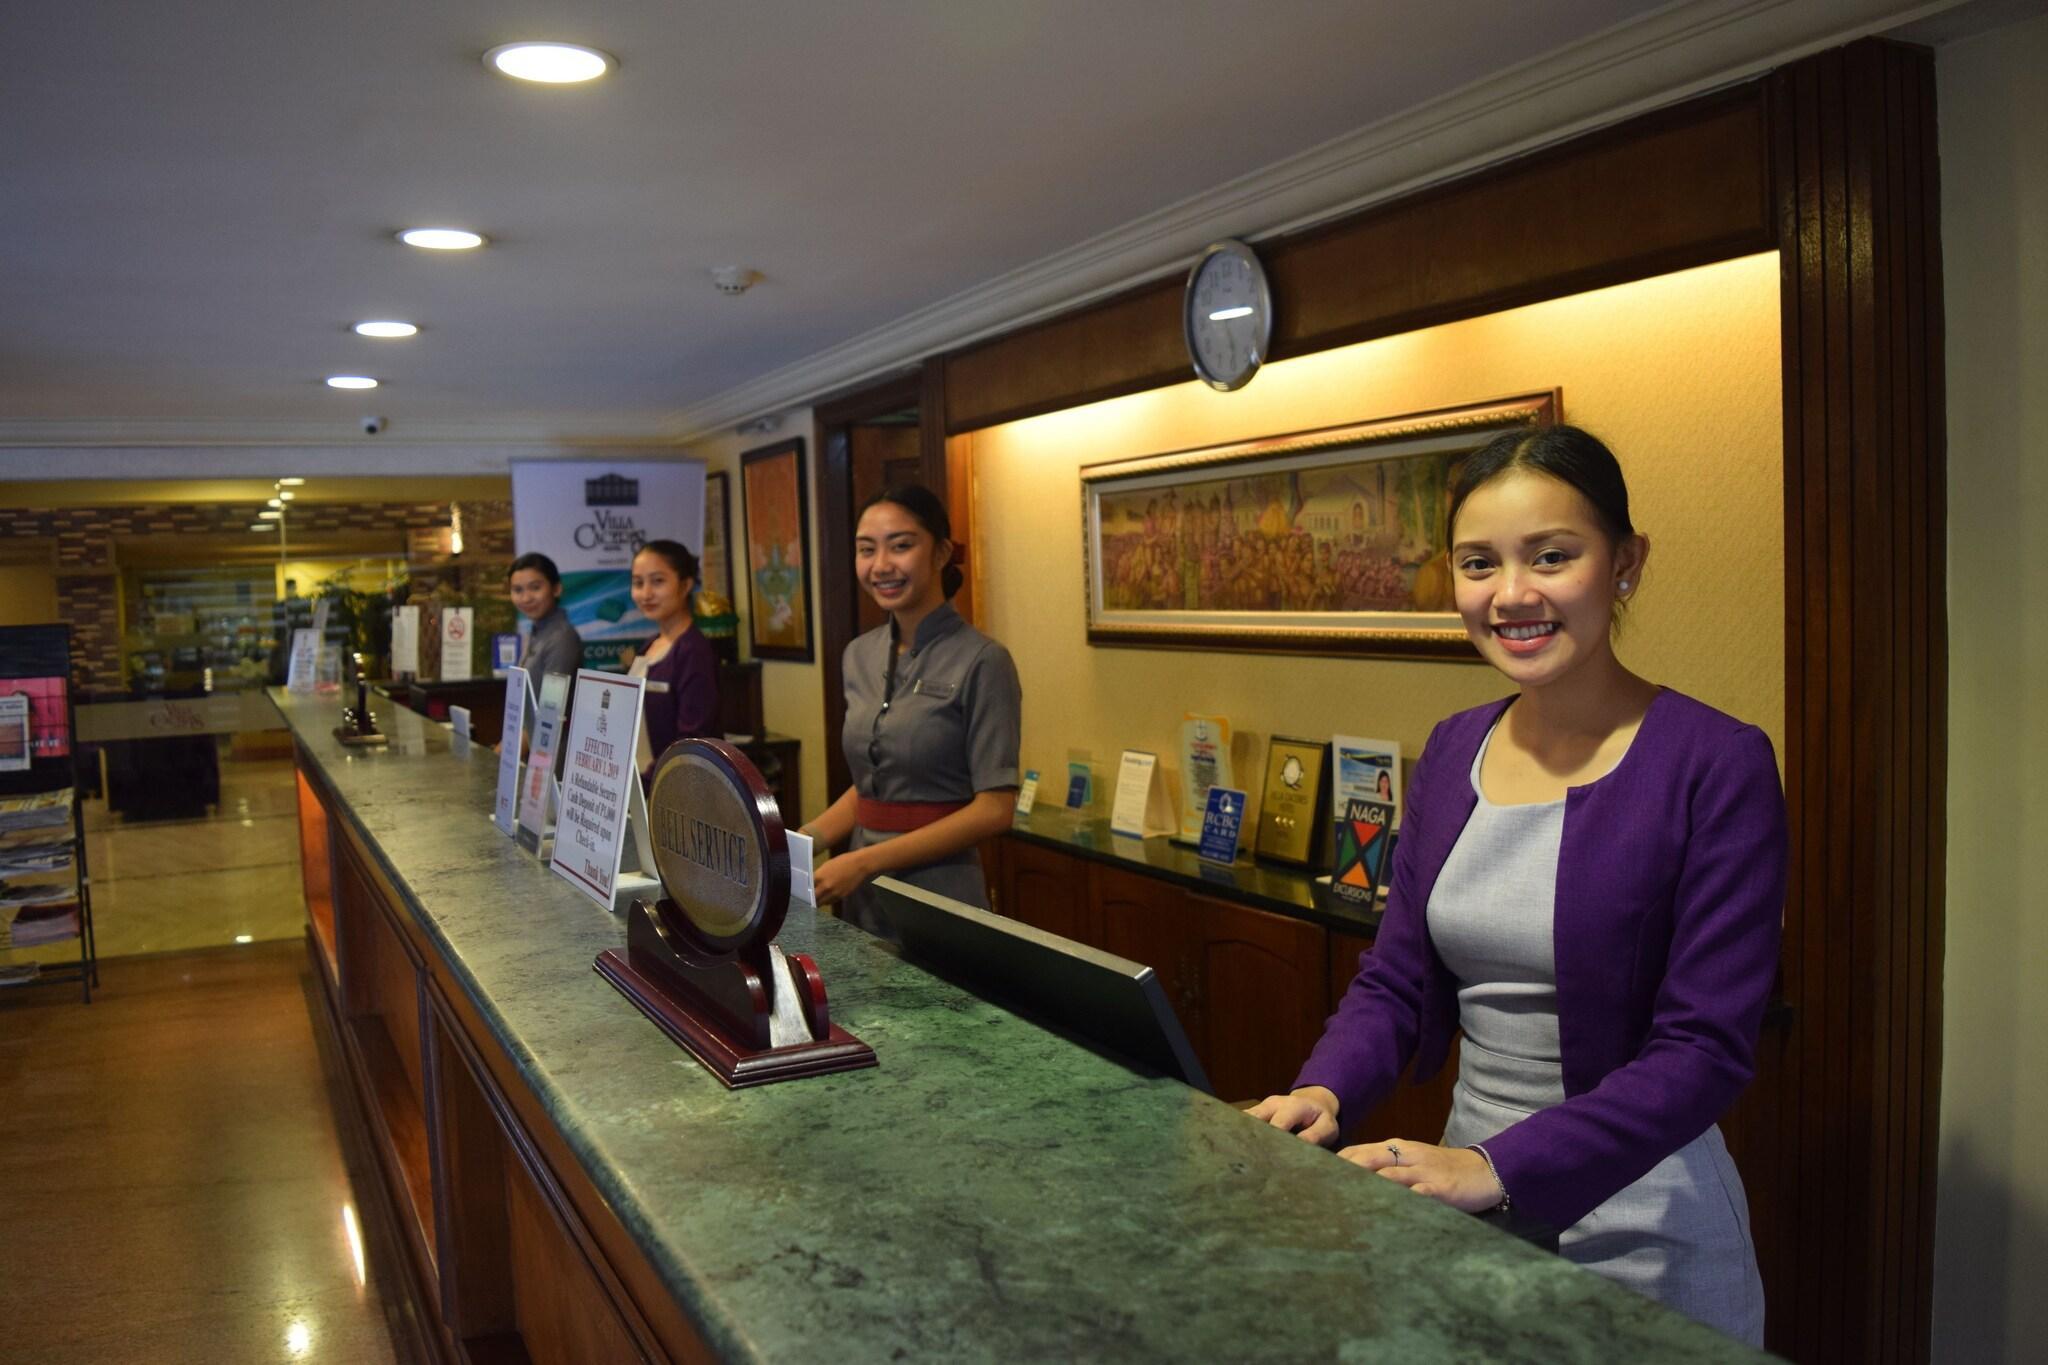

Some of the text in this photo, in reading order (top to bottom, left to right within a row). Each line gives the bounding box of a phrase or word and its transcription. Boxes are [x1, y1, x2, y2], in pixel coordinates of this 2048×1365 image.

[584, 736, 614, 760] EFFECTIVE
[575, 750, 602, 773] FEBRUARY
[574, 771, 599, 795] Refundable
[599, 782, 617, 803] Security
[578, 793, 595, 813] Deposit
[1350, 803, 1386, 826] NAGA
[1206, 811, 1237, 829] RCBC
[658, 805, 748, 886] BELL SERVICE
[584, 858, 599, 881] Thank
